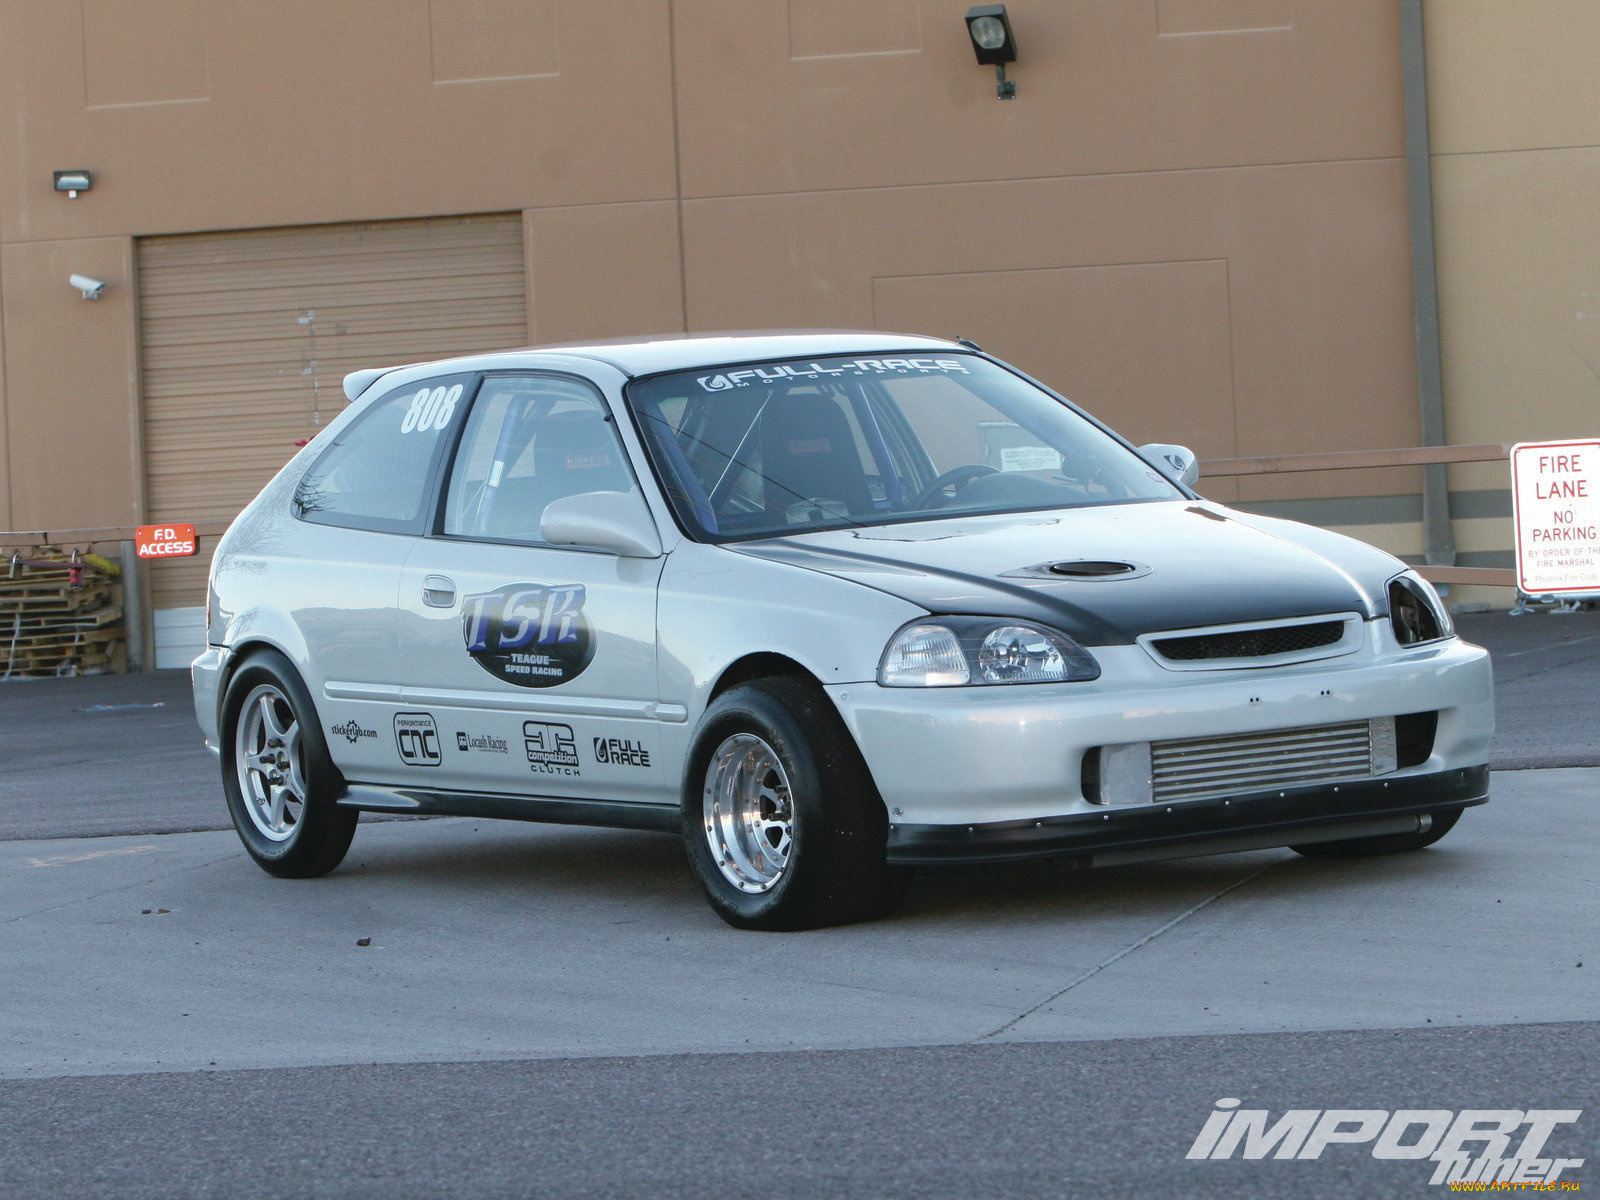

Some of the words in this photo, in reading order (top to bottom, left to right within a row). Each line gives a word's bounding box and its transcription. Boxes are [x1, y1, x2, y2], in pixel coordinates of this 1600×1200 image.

[727, 359, 967, 383] FULL-RACE
[737, 368, 970, 388] MOTORSPORTS
[400, 383, 463, 434] 808
[1539, 454, 1582, 474] FIRE
[1536, 480, 1588, 499] LANE
[1553, 510, 1573, 524] NO
[154, 528, 177, 540] F.D.
[1532, 526, 1597, 542] PARKING
[139, 541, 193, 555] ACCESS
[1543, 548, 1570, 557] ORDER
[1574, 547, 1584, 555] OF
[1557, 558, 1595, 566] MARSHAL
[511, 653, 550, 665] TEAGUE
[505, 664, 531, 674] SPEED
[532, 667, 563, 676] RACING
[331, 724, 378, 738] stickerlab.com
[487, 735, 508, 754] Racing
[608, 738, 649, 754] FULL
[528, 749, 578, 766] competition
[610, 751, 651, 767] RACE
[530, 765, 581, 777] CLUTCH
